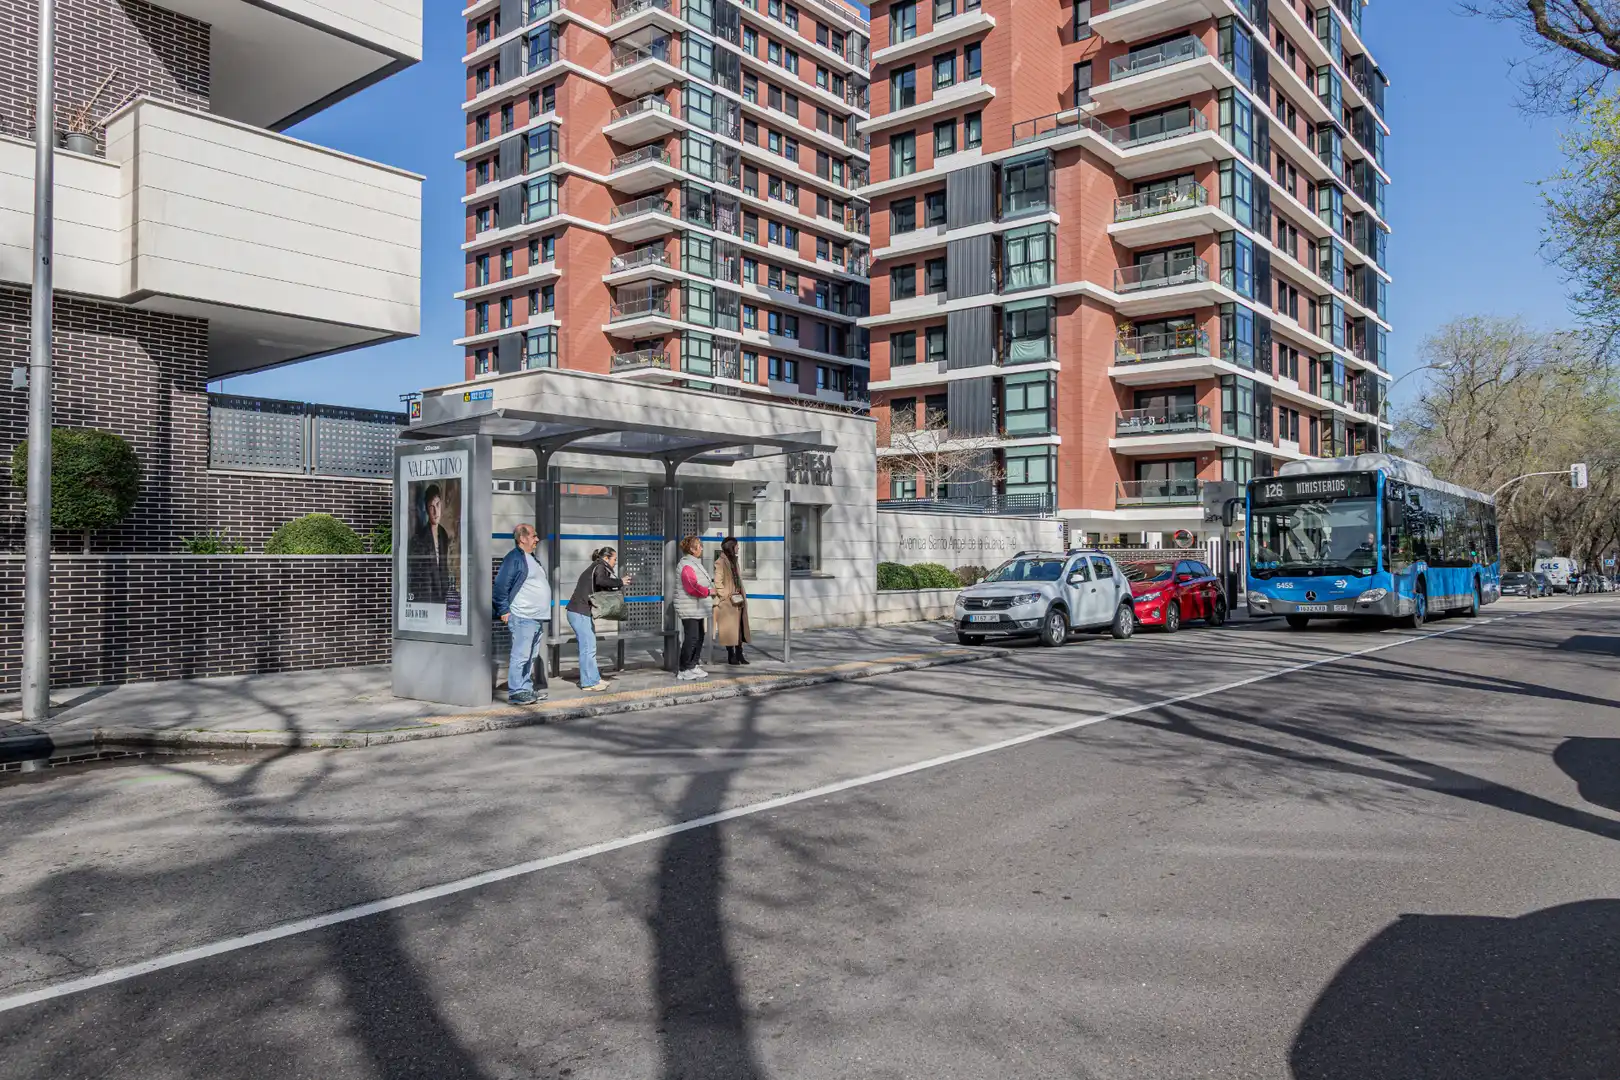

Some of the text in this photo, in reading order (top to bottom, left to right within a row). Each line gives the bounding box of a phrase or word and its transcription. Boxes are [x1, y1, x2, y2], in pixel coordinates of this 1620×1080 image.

[408, 456, 462, 477] VALENTINO
[1265, 480, 1346, 498] 126 MINISTERIOS
